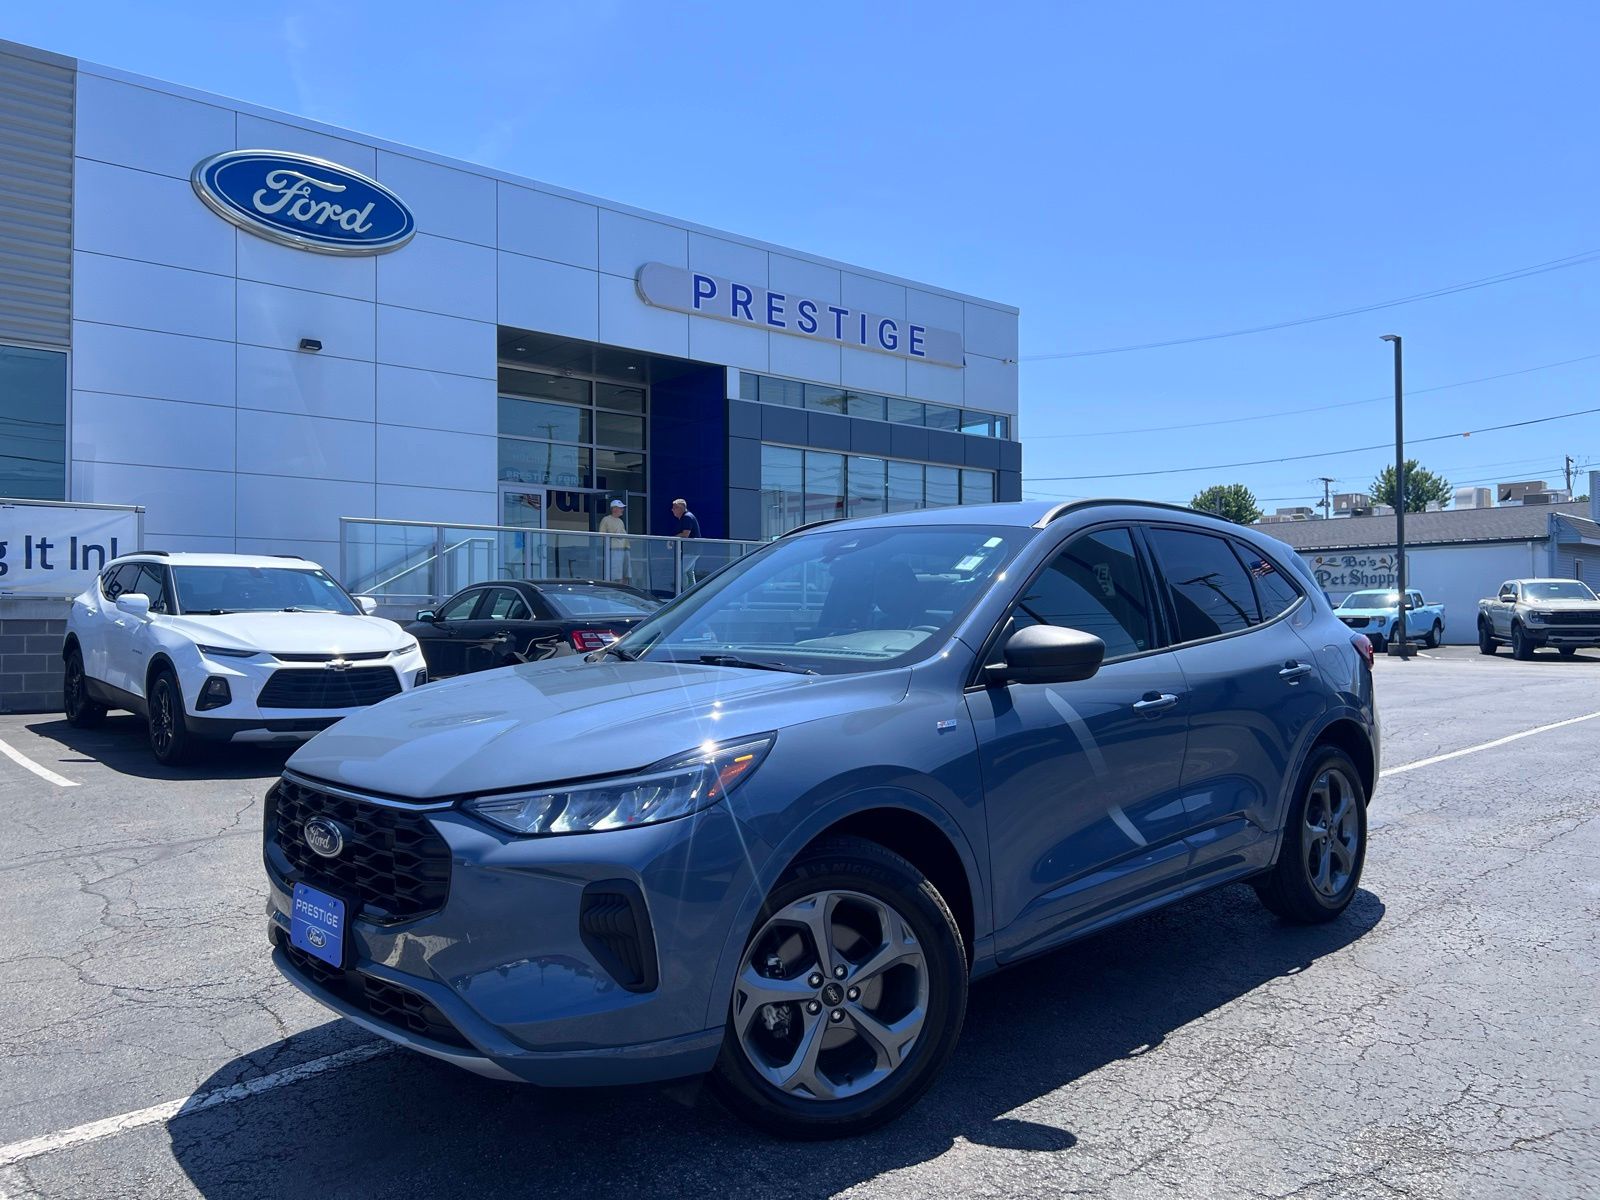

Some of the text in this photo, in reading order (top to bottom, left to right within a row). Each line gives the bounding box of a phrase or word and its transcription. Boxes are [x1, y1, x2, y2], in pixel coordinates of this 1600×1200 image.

[252, 169, 375, 234] Ford
[691, 273, 926, 357] PRESTIGE
[25, 535, 54, 570] It
[1341, 555, 1377, 568] Bo's
[1314, 569, 1399, 588] Pet Shopp
[309, 824, 330, 849] Ford
[295, 898, 338, 928] PRESTIGE
[308, 929, 323, 945] Ford
